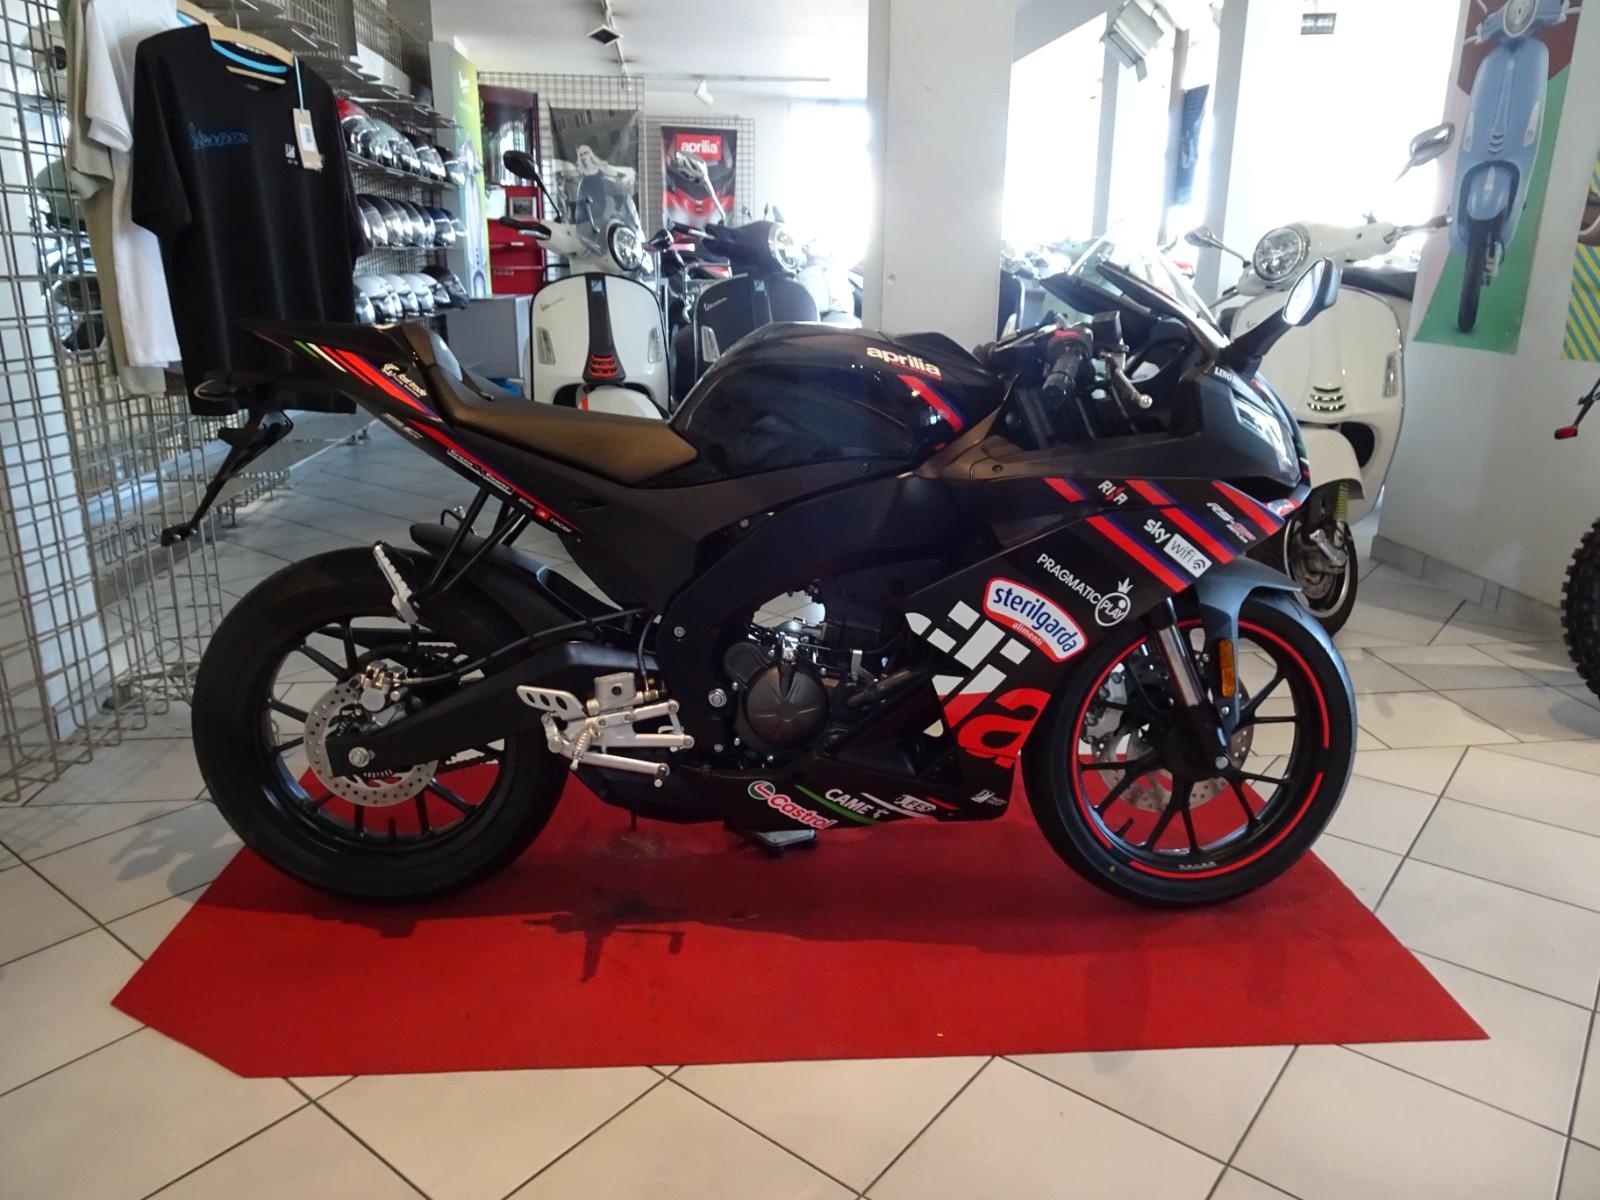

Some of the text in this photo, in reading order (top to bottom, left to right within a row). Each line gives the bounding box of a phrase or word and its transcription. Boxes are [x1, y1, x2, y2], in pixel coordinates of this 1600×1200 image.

[681, 139, 718, 154] aprilia
[866, 347, 942, 378] aprilia
[1143, 518, 1195, 564] sky wifi
[1036, 552, 1126, 620] PRAGMATIC PLAY
[993, 587, 1078, 653] sterilgarda
[1011, 621, 1043, 647] alimenti
[767, 793, 838, 829] Castrol
[825, 788, 873, 815] CAME
